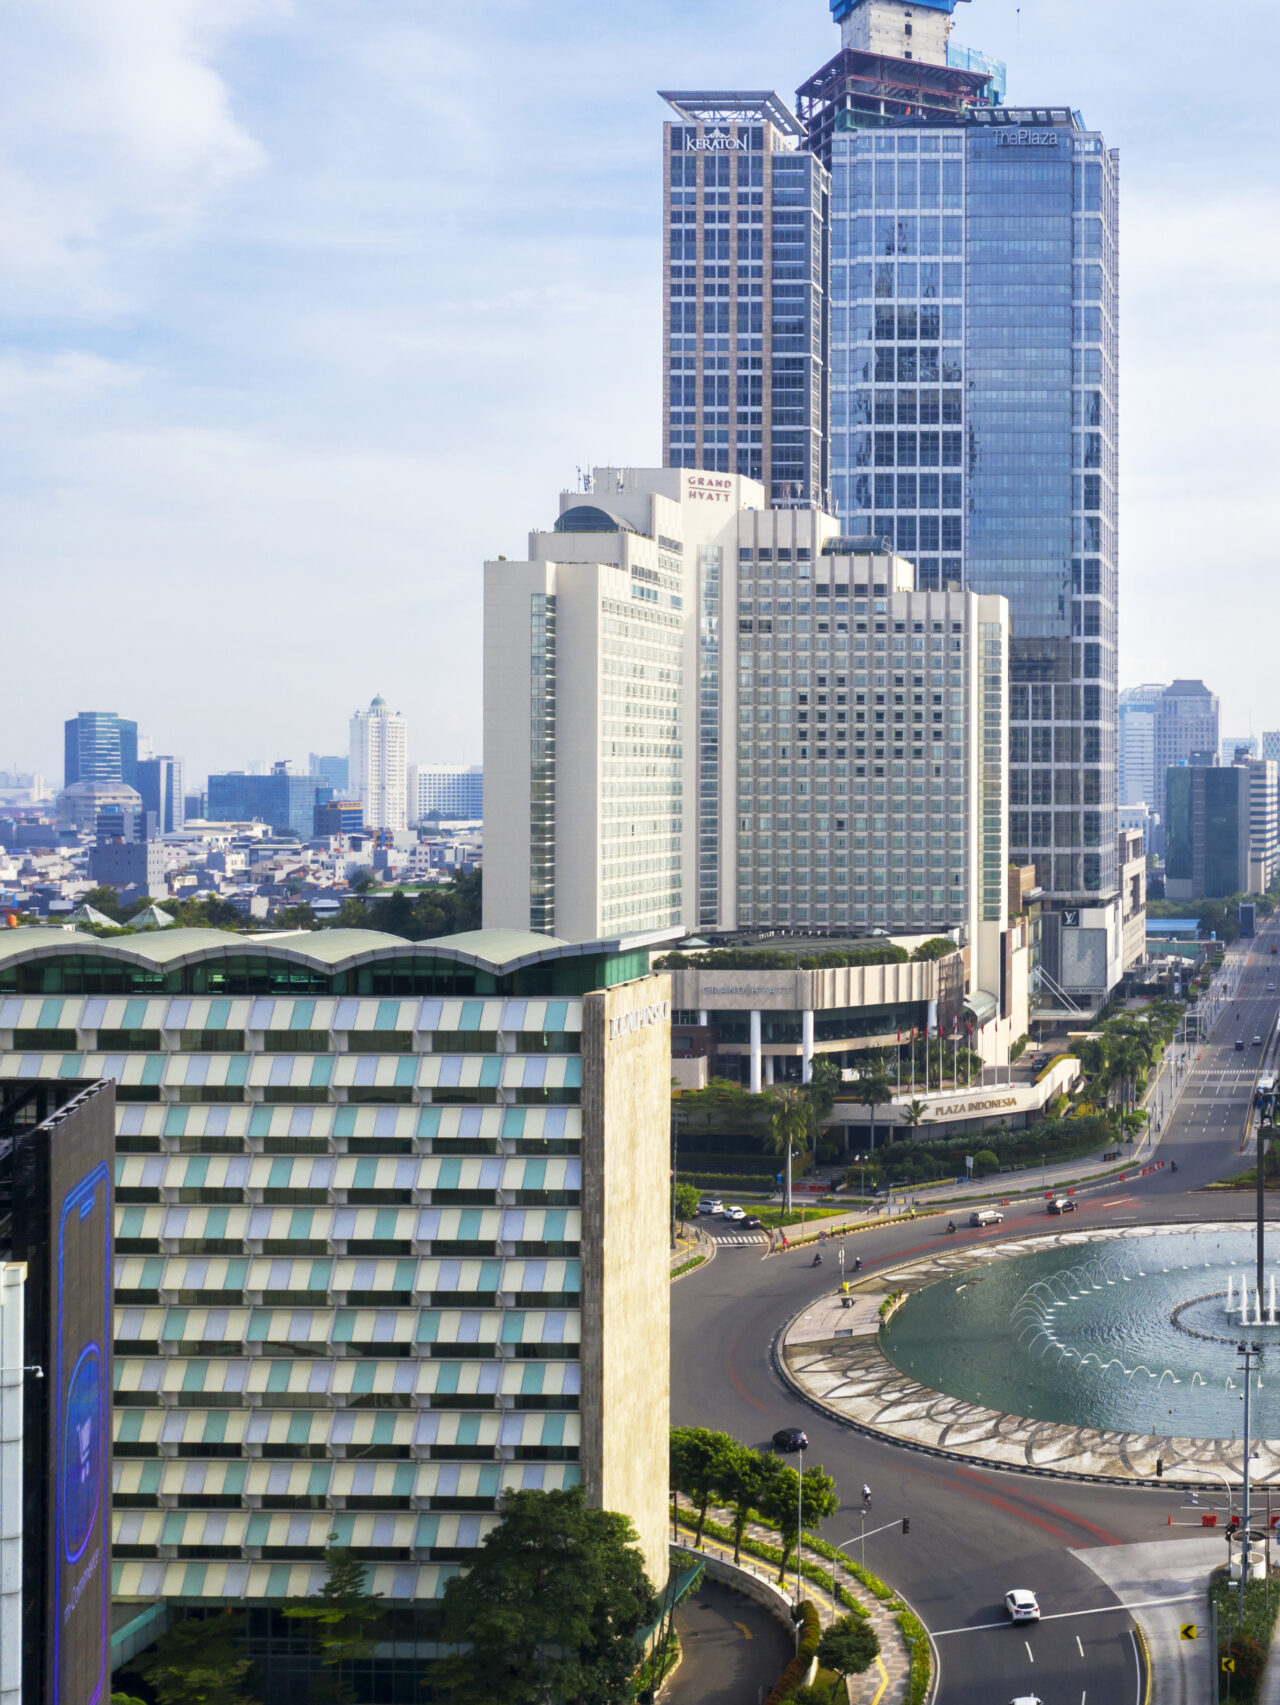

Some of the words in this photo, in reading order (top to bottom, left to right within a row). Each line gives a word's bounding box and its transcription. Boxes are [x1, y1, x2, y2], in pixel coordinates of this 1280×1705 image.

[686, 133, 748, 152] KERATON
[688, 476, 732, 489] GRAND
[688, 490, 730, 502] HYATT
[703, 985, 744, 994] GRAND
[751, 985, 792, 994] HYATT
[936, 1103, 966, 1116] PLAZA
[969, 1097, 1017, 1111] INDONESIA
